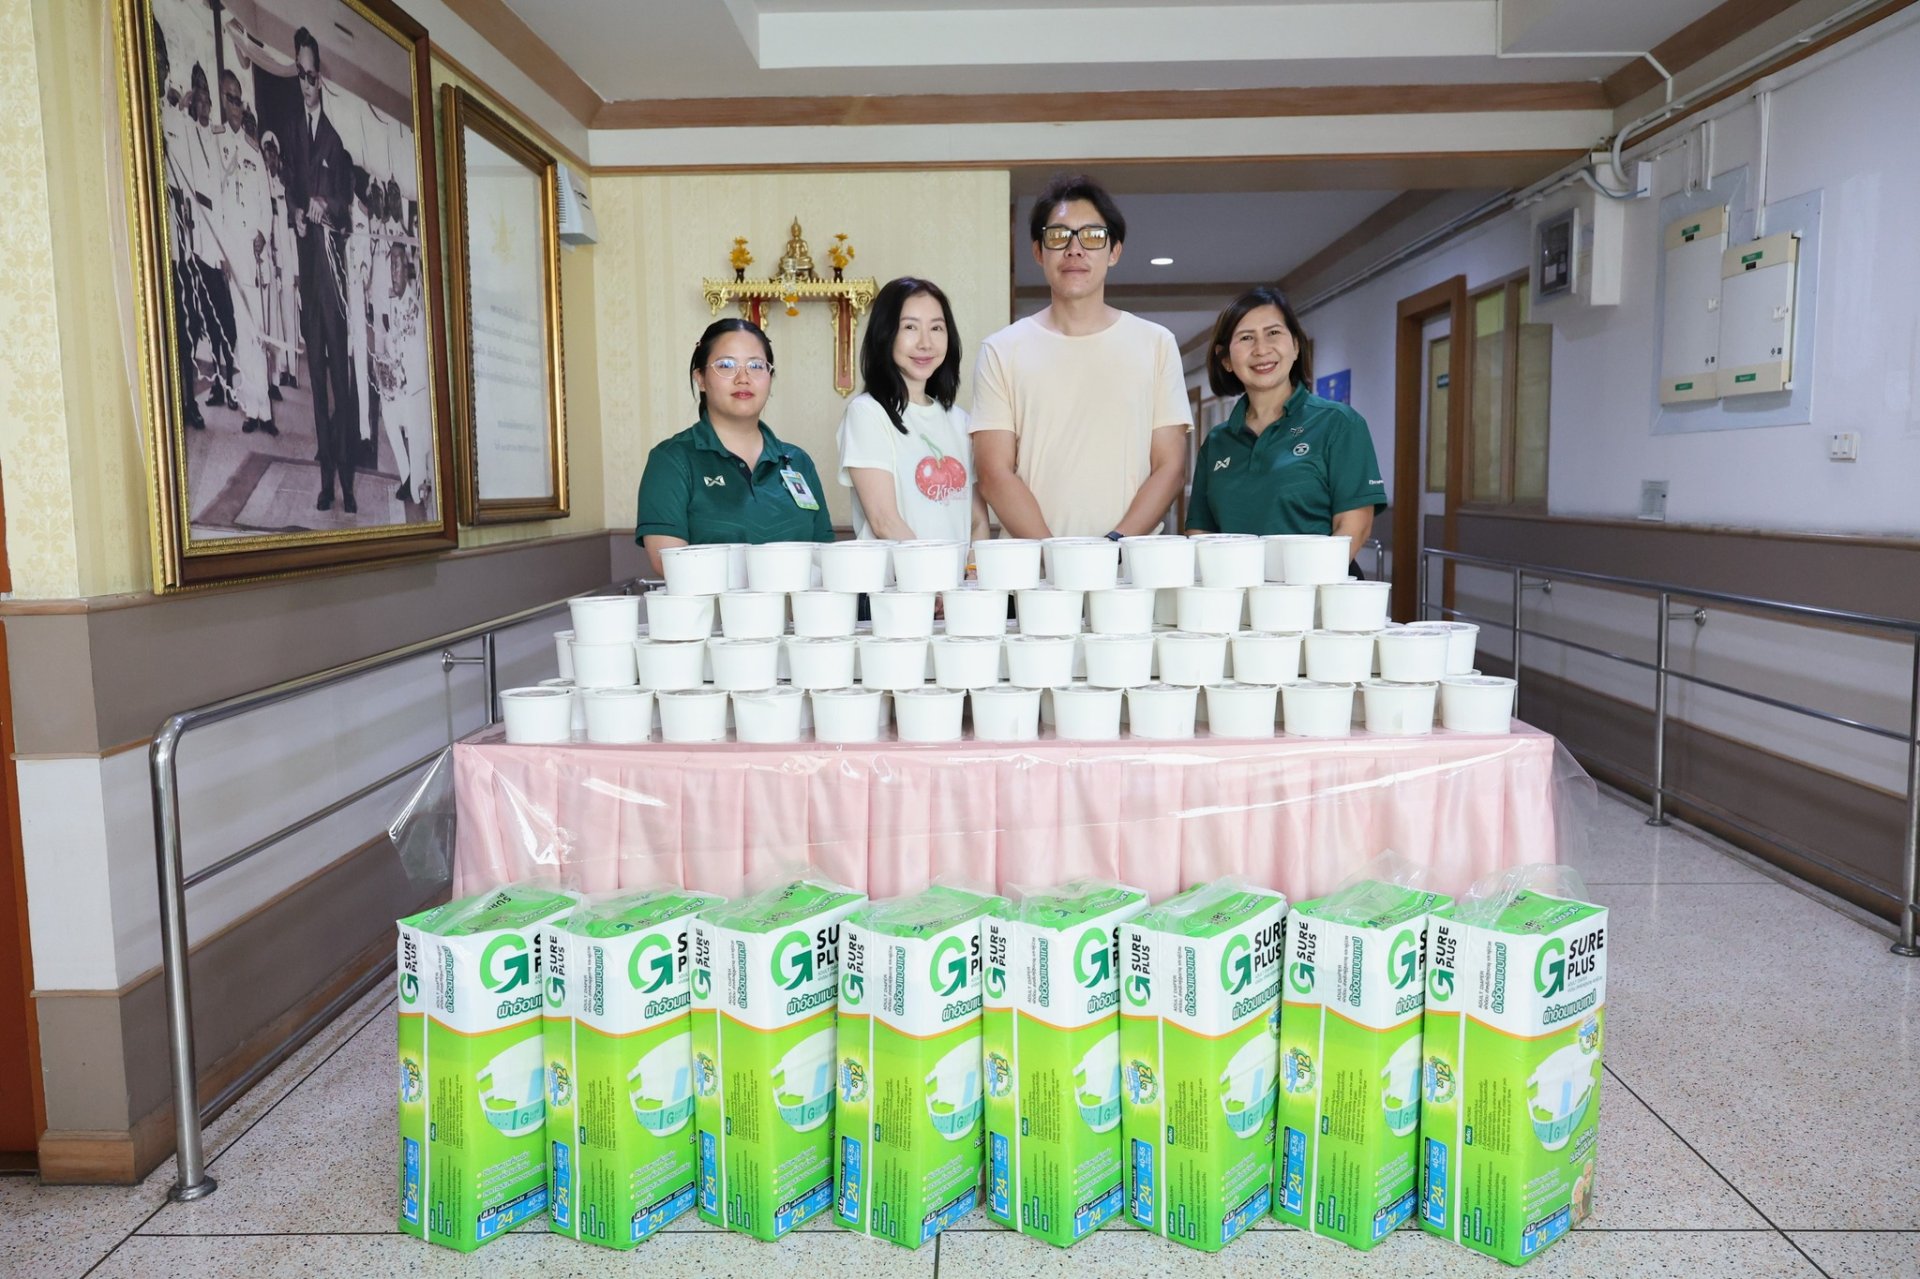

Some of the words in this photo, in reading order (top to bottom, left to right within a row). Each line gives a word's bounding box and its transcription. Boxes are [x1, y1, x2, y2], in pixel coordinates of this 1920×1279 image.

[696, 928, 704, 966] SURE
[817, 924, 839, 949] SU
[990, 925, 999, 963] SURE
[1254, 916, 1287, 953] SURE
[1297, 921, 1309, 960] SURE
[1307, 933, 1317, 963] PLUS
[1436, 925, 1449, 966] SURE
[1569, 929, 1604, 960] SURE
[403, 932, 411, 969] SURE
[479, 933, 529, 994] G
[549, 936, 558, 973] SURE
[628, 933, 673, 994] G
[771, 930, 813, 990] G
[848, 933, 857, 970] SURE
[856, 944, 864, 974] PLUS
[1073, 927, 1109, 988] G
[1132, 934, 1141, 972] SURE
[1142, 945, 1150, 975] PLUS
[1220, 934, 1252, 995] G
[1254, 943, 1282, 972] PLUS
[1387, 928, 1417, 990] G
[1446, 938, 1456, 969] PLUS
[930, 936, 967, 996] G
[1289, 962, 1315, 995] G
[1534, 937, 1565, 998] G
[1568, 955, 1595, 980] PLUS
[400, 972, 419, 1005] G
[545, 976, 566, 1008] G
[691, 968, 711, 1000] G
[842, 973, 863, 1005] G
[984, 967, 1006, 999] G
[1125, 975, 1151, 1007] G
[1429, 968, 1454, 1002] G
[408, 1183, 418, 1203] 24
[559, 1187, 568, 1207] 24
[706, 1176, 716, 1195] 24
[847, 1182, 858, 1202] 24
[996, 1178, 1007, 1198] 24
[1140, 1185, 1151, 1206] 24
[1289, 1173, 1302, 1195] 24
[1431, 1185, 1444, 1207] 24
[408, 1209, 417, 1220] L
[558, 1212, 568, 1223] L
[706, 1201, 716, 1212] L
[779, 1218, 787, 1232] L
[791, 1205, 805, 1225] 24
[846, 1208, 857, 1219] L
[996, 1205, 1007, 1214] L
[1077, 1219, 1085, 1234] L
[1089, 1207, 1101, 1226] 24
[1140, 1211, 1152, 1222] L
[1287, 1200, 1301, 1211] L
[1429, 1213, 1444, 1224] L
[481, 1222, 491, 1238] L
[496, 1210, 513, 1229] 24
[635, 1222, 644, 1238] L
[649, 1210, 664, 1230] 24
[924, 1226, 931, 1240] L
[935, 1214, 948, 1233] 24
[1224, 1225, 1231, 1239] L
[1235, 1213, 1247, 1231] 24
[1375, 1223, 1382, 1237] L
[1385, 1210, 1397, 1230] 24
[1525, 1238, 1532, 1253] L
[1536, 1227, 1547, 1248] 24
